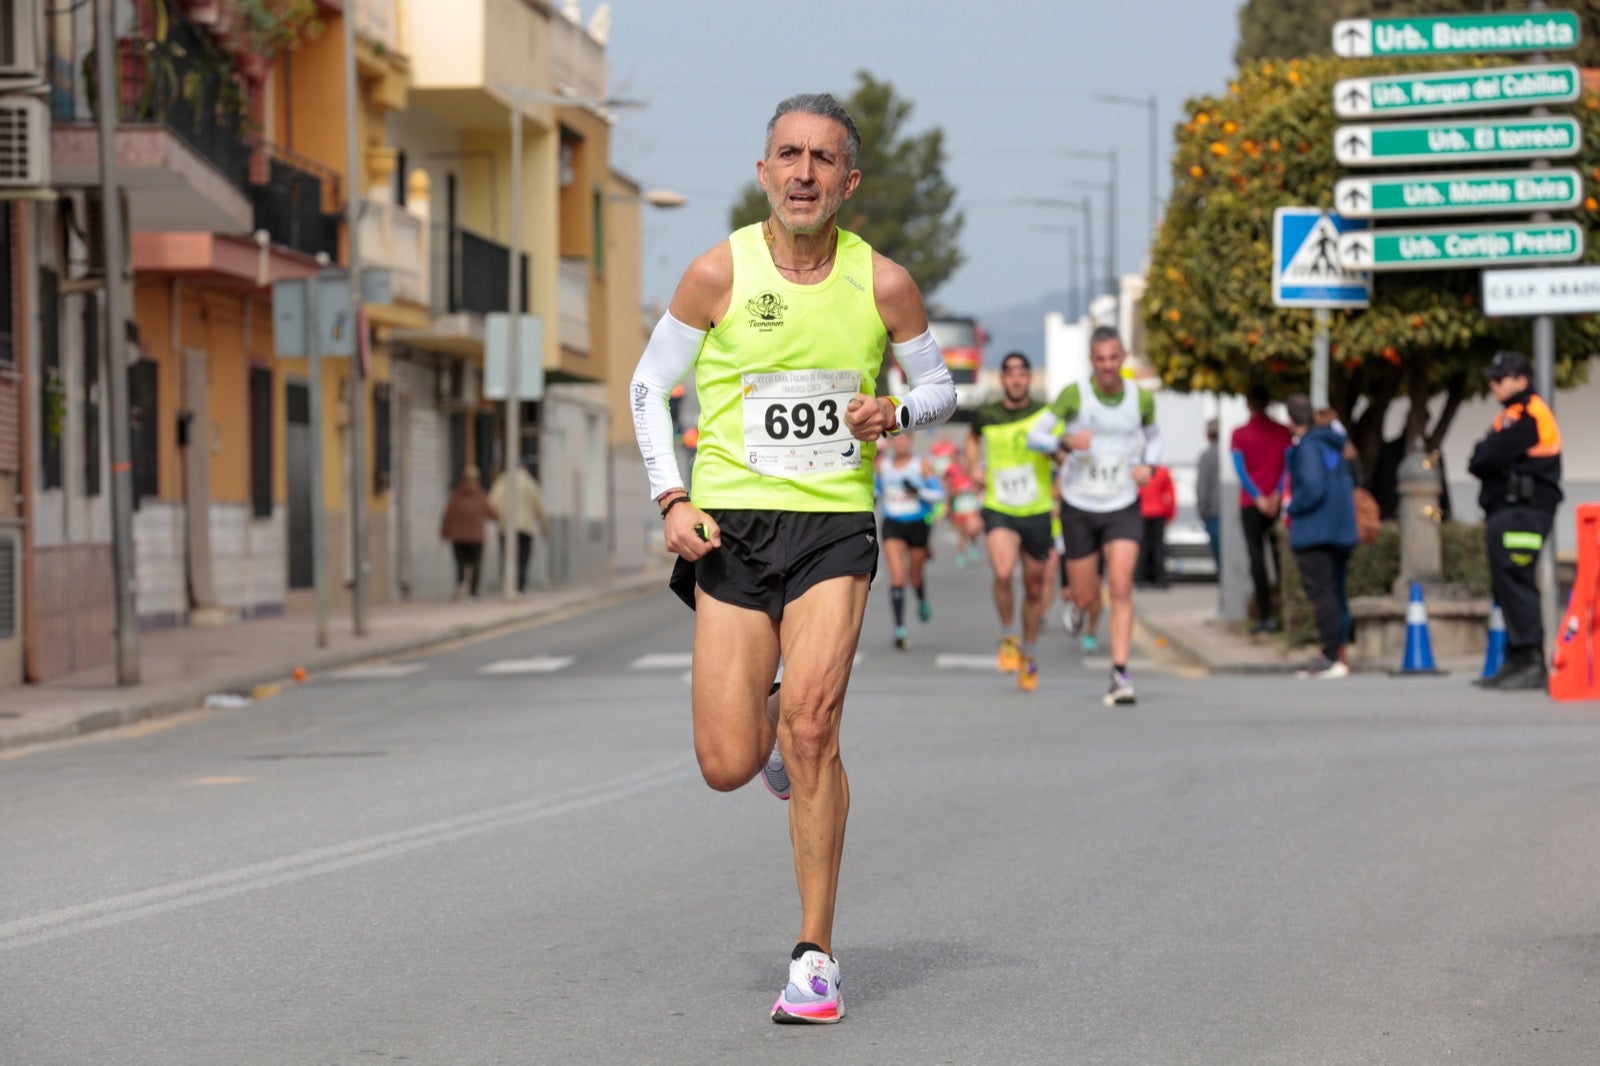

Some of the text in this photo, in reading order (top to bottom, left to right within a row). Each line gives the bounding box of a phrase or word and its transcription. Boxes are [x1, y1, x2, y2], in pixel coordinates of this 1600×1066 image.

[1375, 18, 1574, 50] Urb. Buenavista
[1373, 72, 1569, 106] Urb. Parque del Cubillas
[1428, 129, 1470, 151] Urb.
[1474, 127, 1495, 149] El
[1403, 177, 1570, 206] Urb. Monte Elvira
[1399, 237, 1441, 260] Urb.
[1444, 234, 1510, 258] Cortijo
[764, 399, 840, 440] 693
